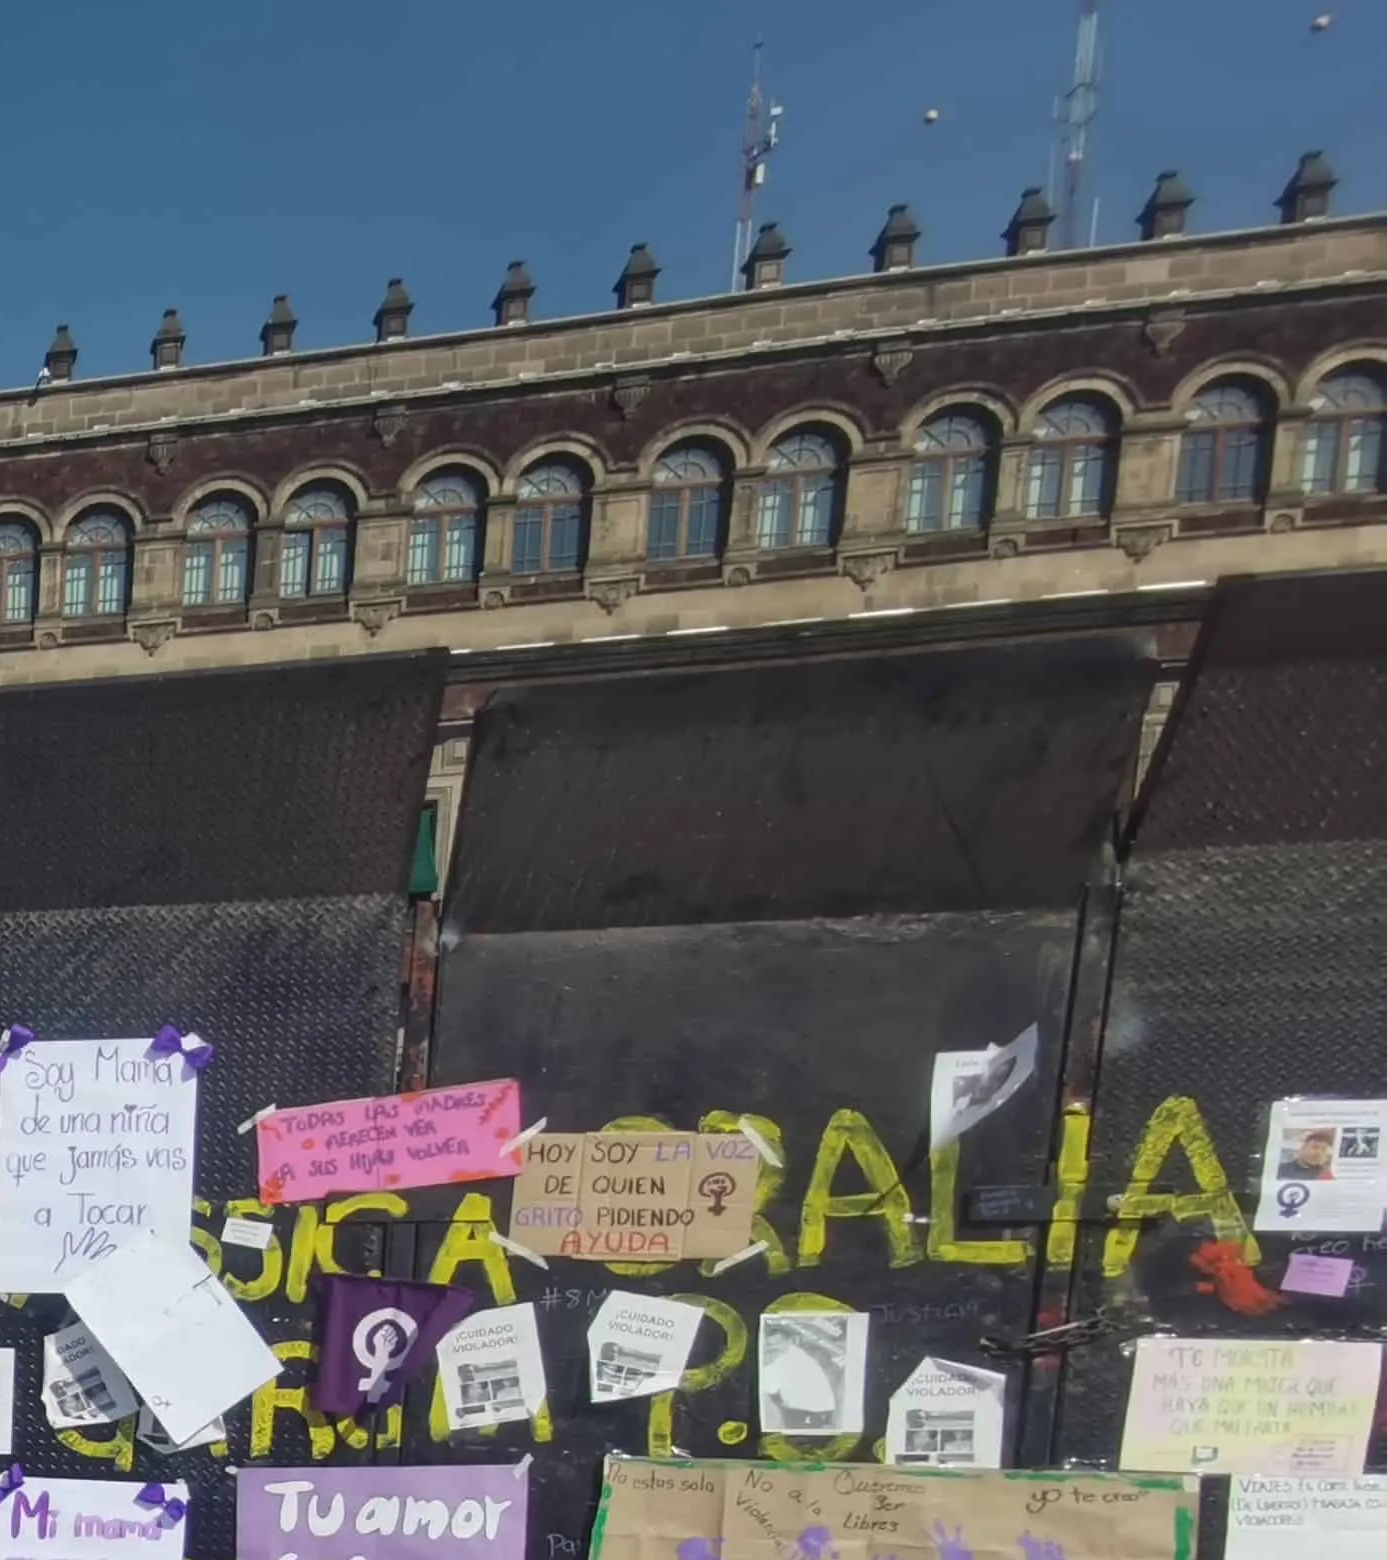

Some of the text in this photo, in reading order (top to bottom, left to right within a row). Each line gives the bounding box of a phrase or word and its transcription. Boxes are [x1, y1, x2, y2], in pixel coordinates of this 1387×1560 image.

[25, 1050, 74, 1103] Soy
[21, 1094, 169, 1135] de una niña
[280, 1093, 489, 1135] TODAS LAS MADRES
[325, 1121, 437, 1150] MERECEN VER
[528, 1141, 755, 1164] HOY SOY LA VOZ
[6, 1147, 186, 1187] que vas
[308, 1137, 470, 1176] SUS HIJAS VOLVER
[544, 1176, 665, 1195] DE QUIEN
[35, 1207, 51, 1226] a
[515, 1207, 694, 1227] GRITO PIDIENDO
[561, 1231, 669, 1254] AYUDA
[11, 1489, 58, 1541] Mi
[264, 1480, 512, 1541] Tu amor
